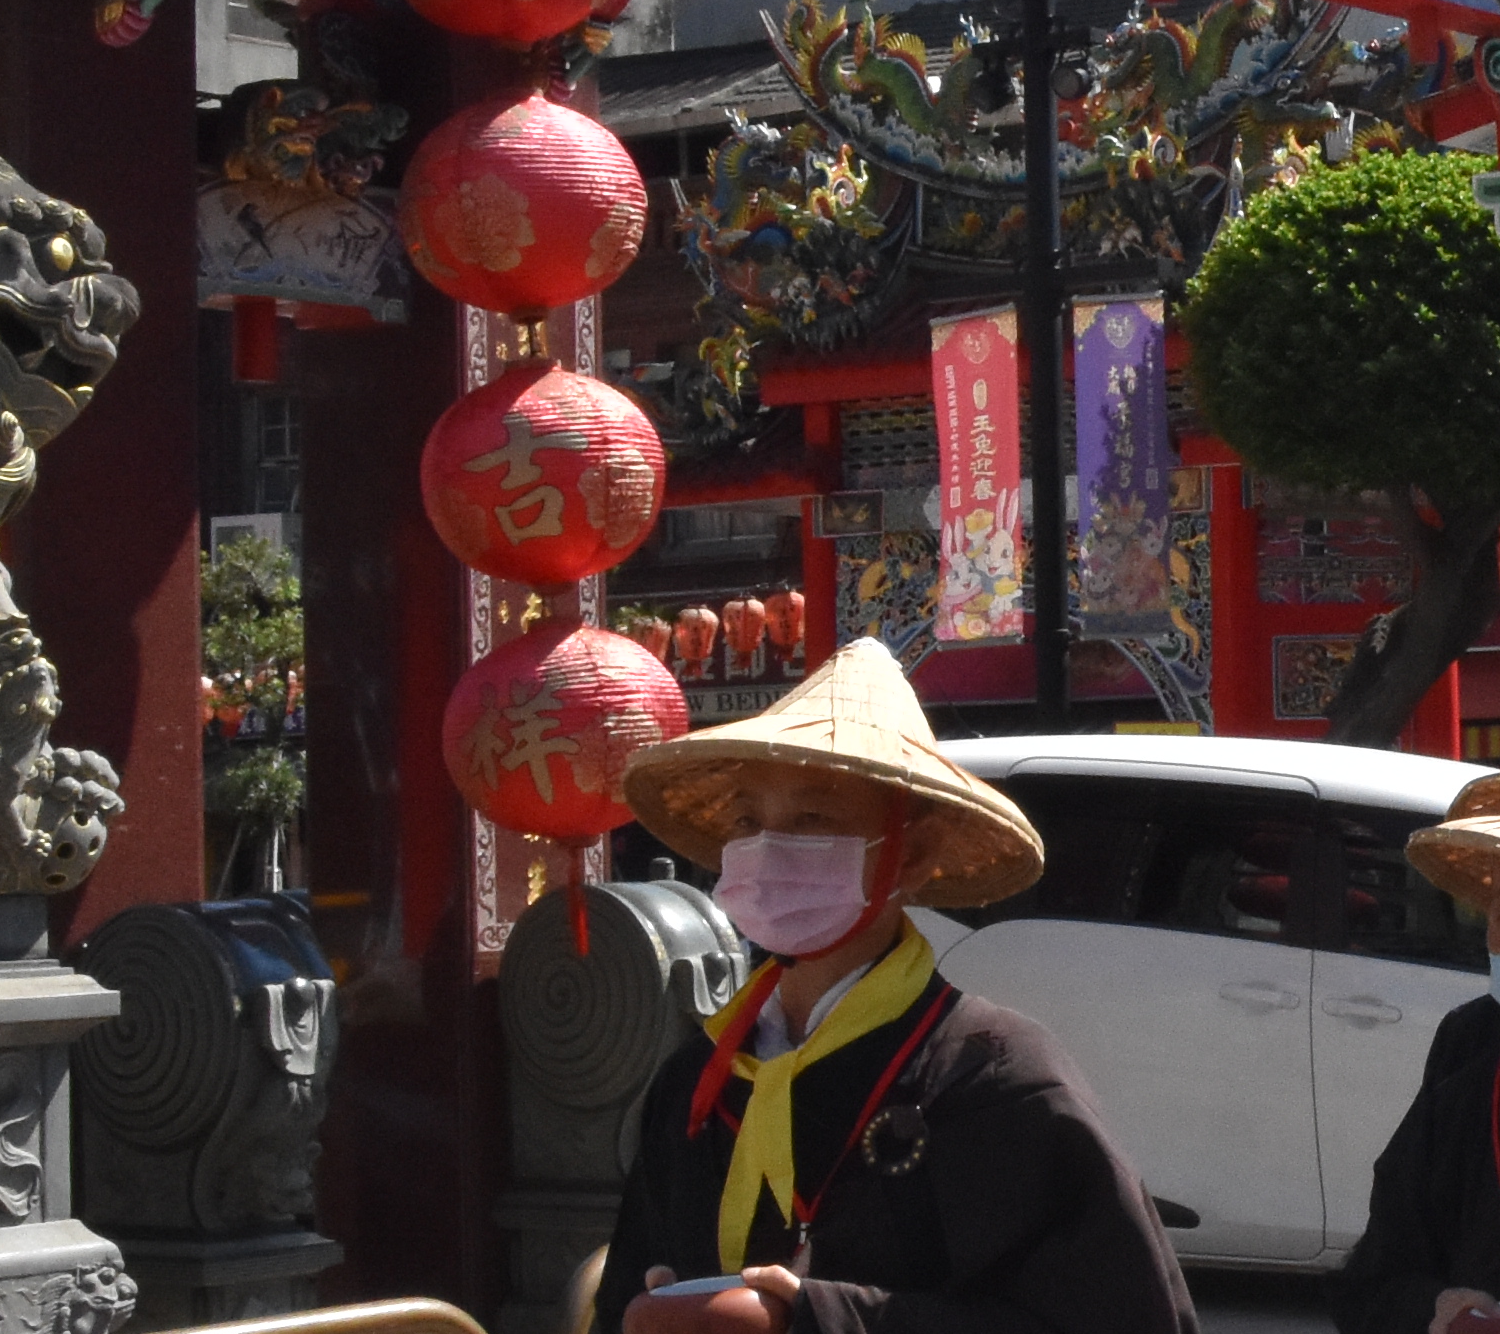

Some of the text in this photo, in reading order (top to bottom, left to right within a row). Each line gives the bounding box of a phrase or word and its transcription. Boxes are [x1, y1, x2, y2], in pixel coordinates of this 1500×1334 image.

[463, 413, 589, 545] 吉
[969, 414, 998, 500] 玉兔迎春
[464, 672, 581, 805] 祥
